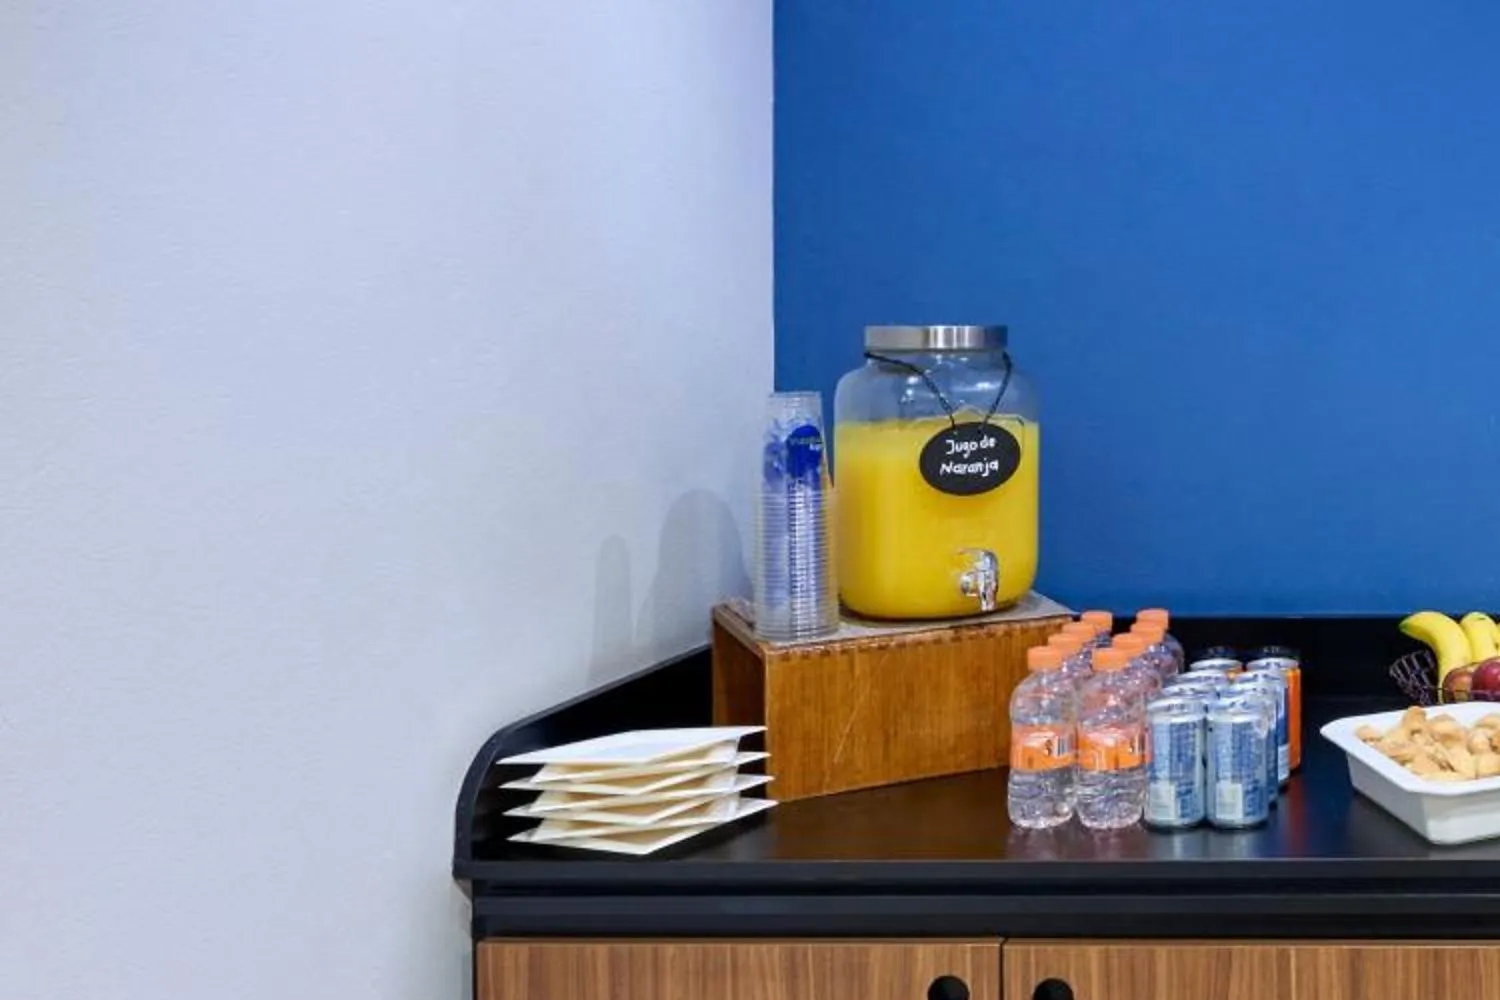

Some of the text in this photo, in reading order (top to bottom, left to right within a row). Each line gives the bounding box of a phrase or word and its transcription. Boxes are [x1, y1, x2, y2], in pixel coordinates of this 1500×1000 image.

[945, 434, 997, 459] Jugo de
[939, 457, 999, 477] Naranja
